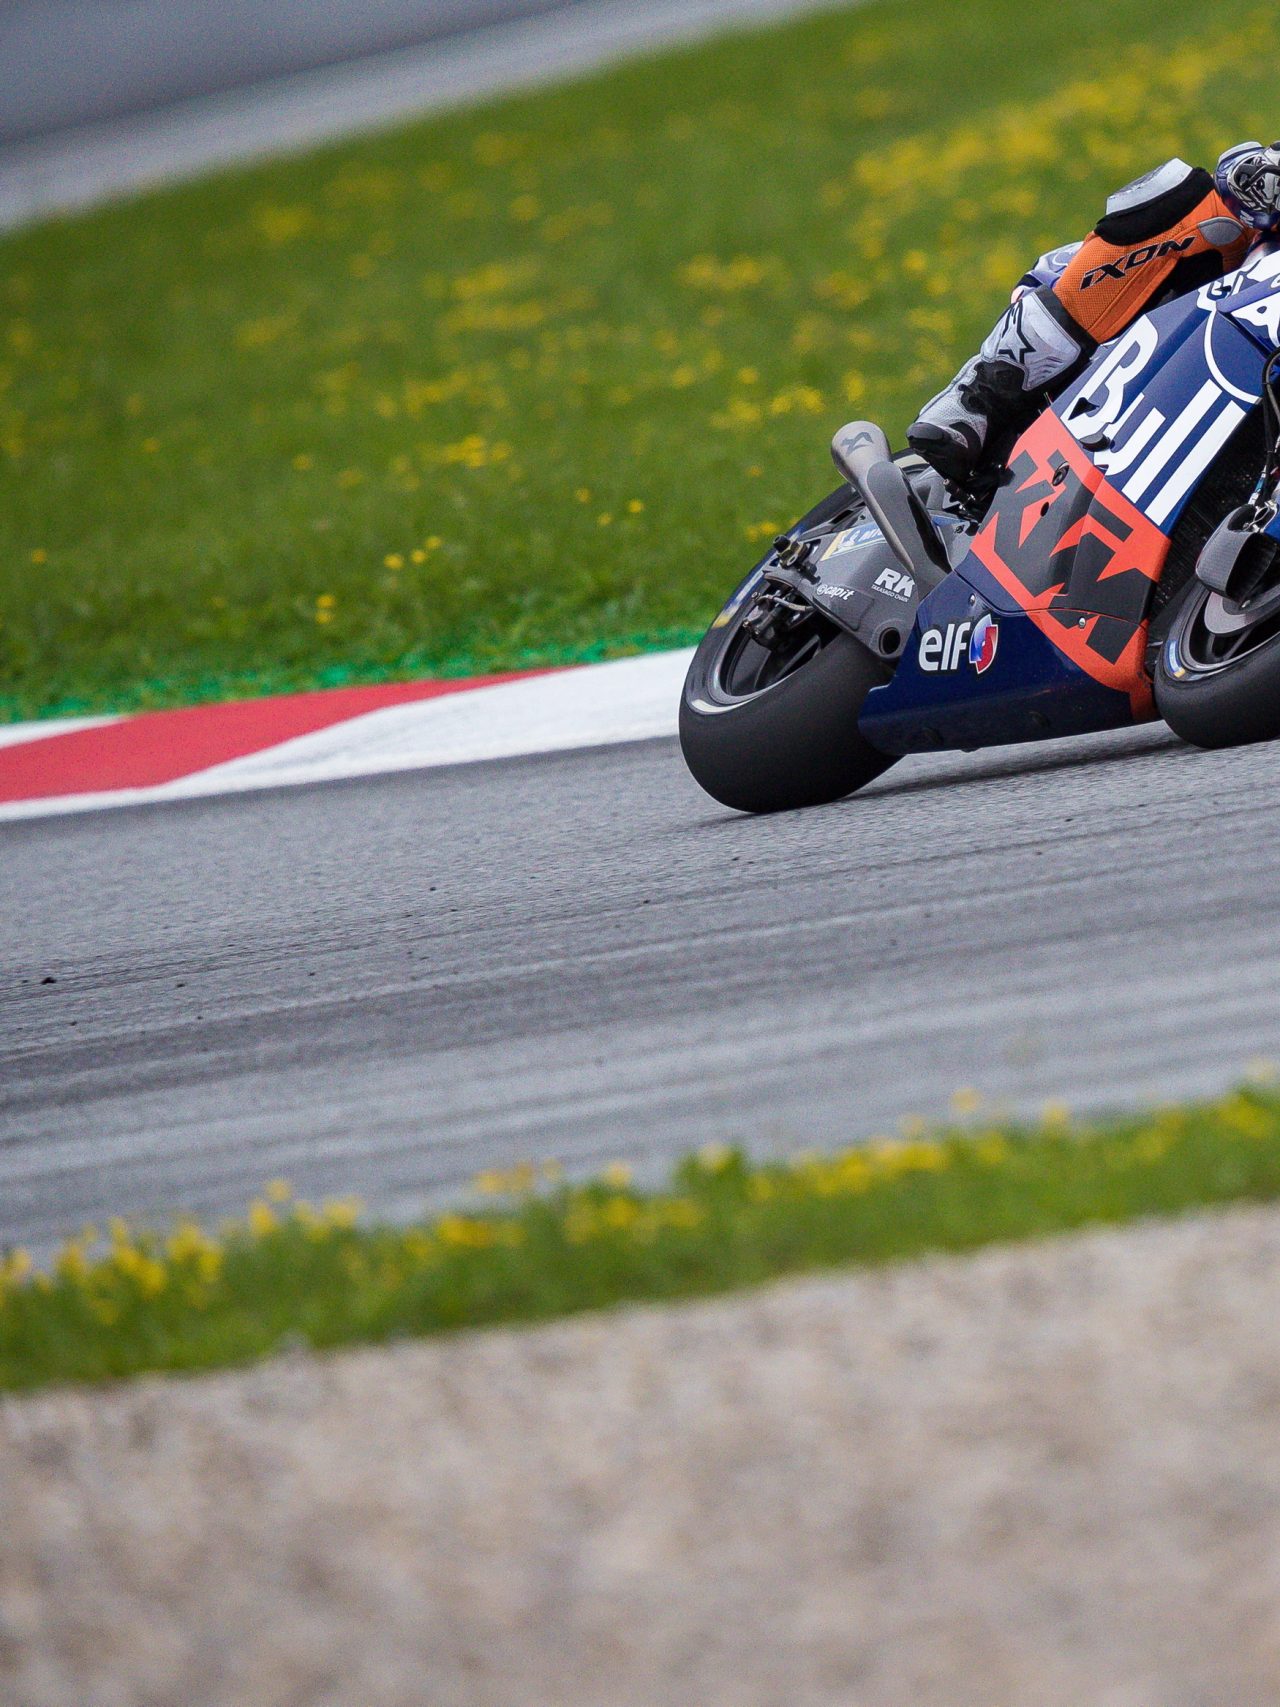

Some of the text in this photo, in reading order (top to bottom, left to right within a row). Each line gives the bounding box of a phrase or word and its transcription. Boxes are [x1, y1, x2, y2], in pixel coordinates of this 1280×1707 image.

[1060, 314, 1247, 527] Bull
[874, 567, 916, 598] RK
[977, 449, 1158, 666] KTM
[918, 622, 971, 673] elf
